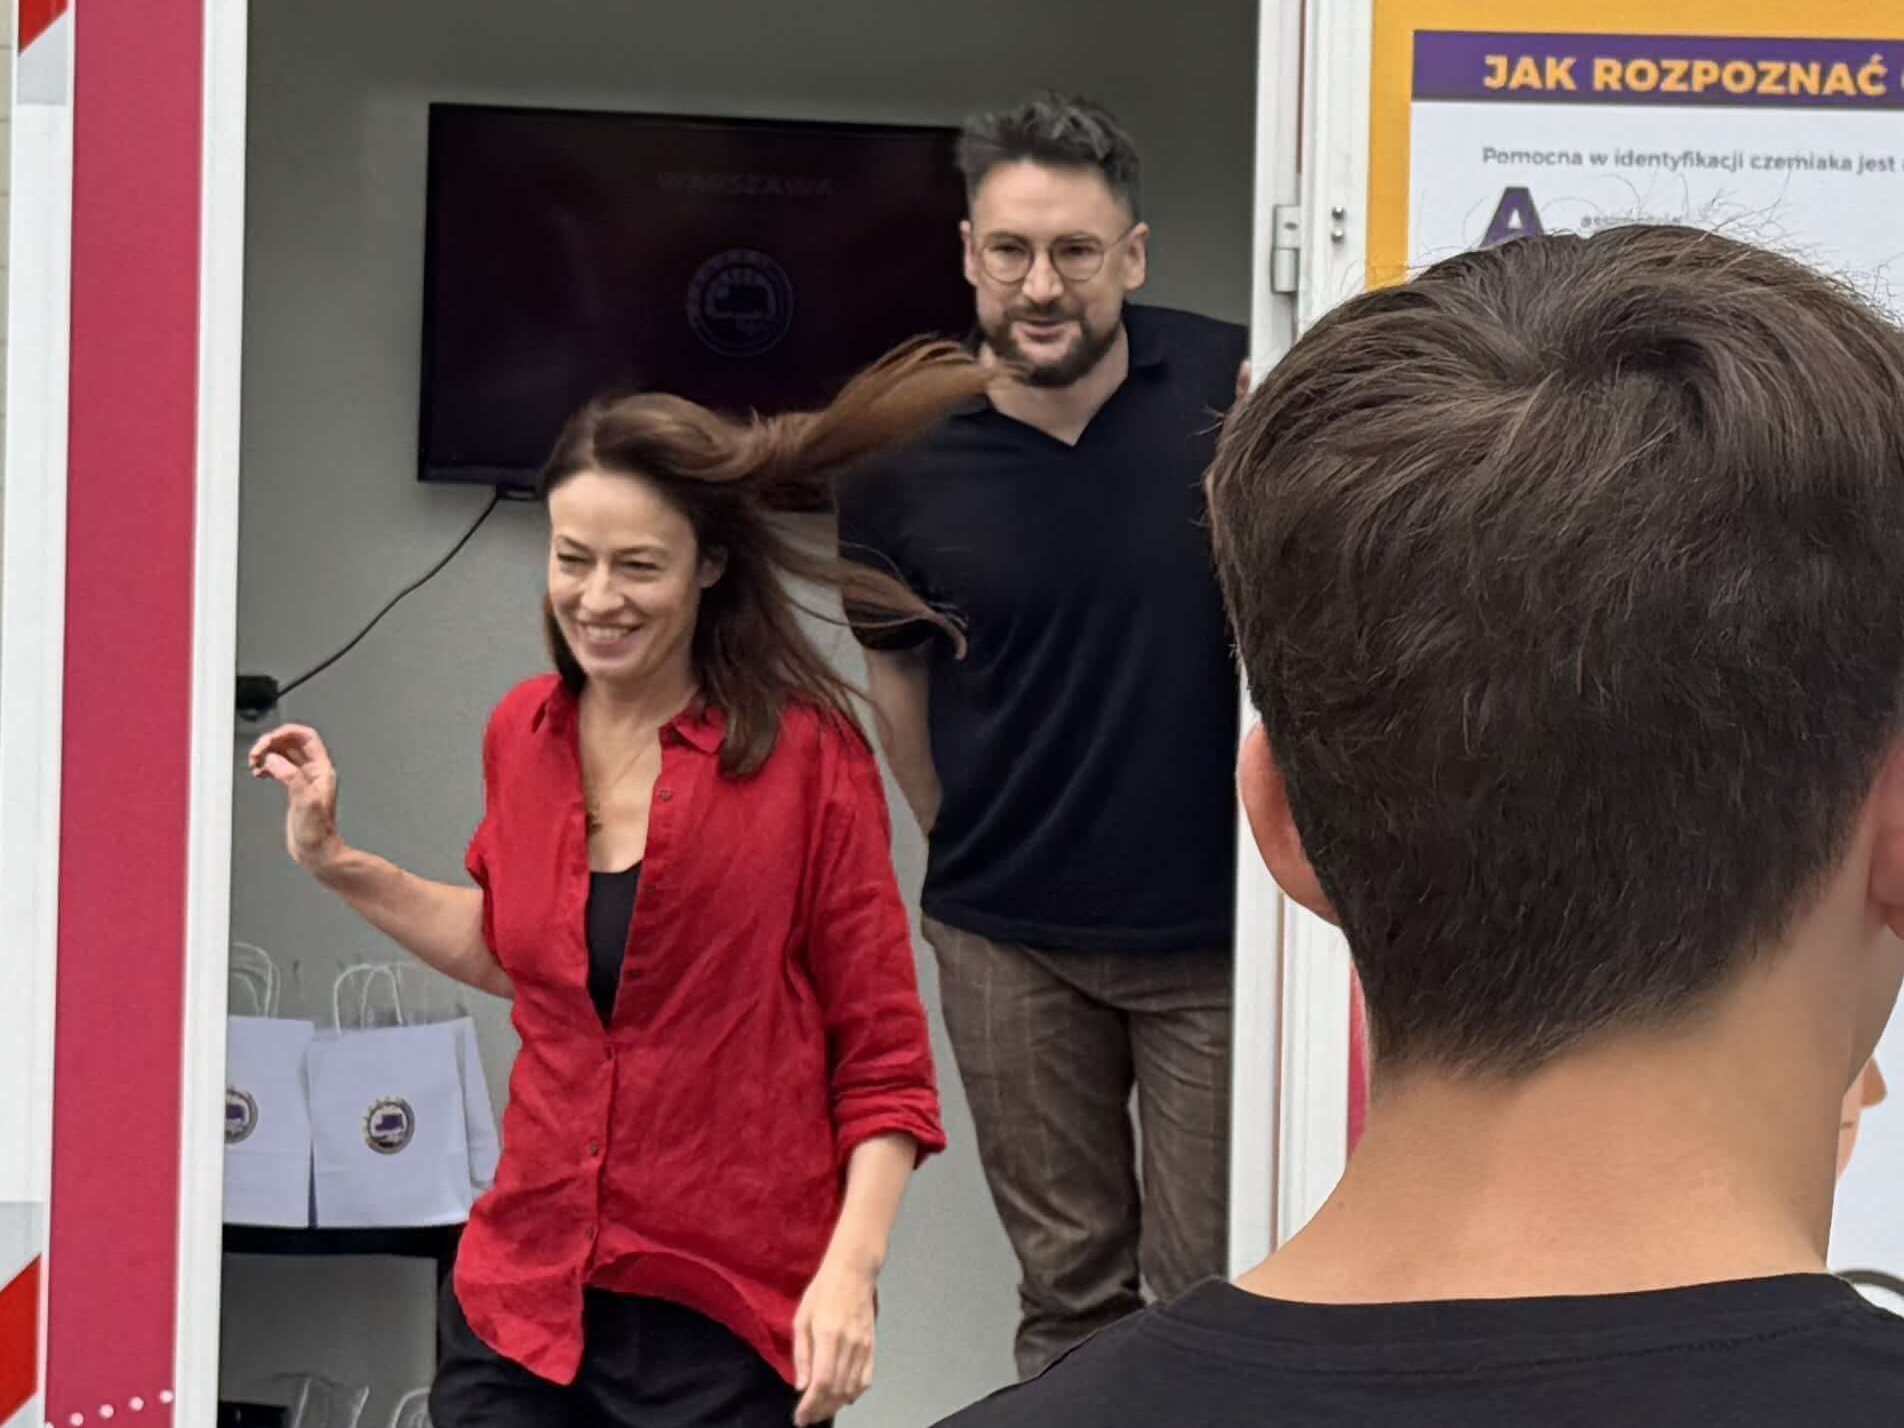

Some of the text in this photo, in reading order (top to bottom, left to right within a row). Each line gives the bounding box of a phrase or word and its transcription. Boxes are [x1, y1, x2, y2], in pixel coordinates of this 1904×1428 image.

[1482, 53, 1578, 92] JAK
[1593, 54, 1888, 97] ROZPOZNAĆ
[1482, 147, 1583, 166] Pomocna
[1589, 152, 1608, 166] w
[1614, 147, 1744, 172] identyfikacji
[1749, 151, 1852, 172] czerniaka
[1856, 152, 1896, 175] jest
[1479, 186, 1546, 248] A
